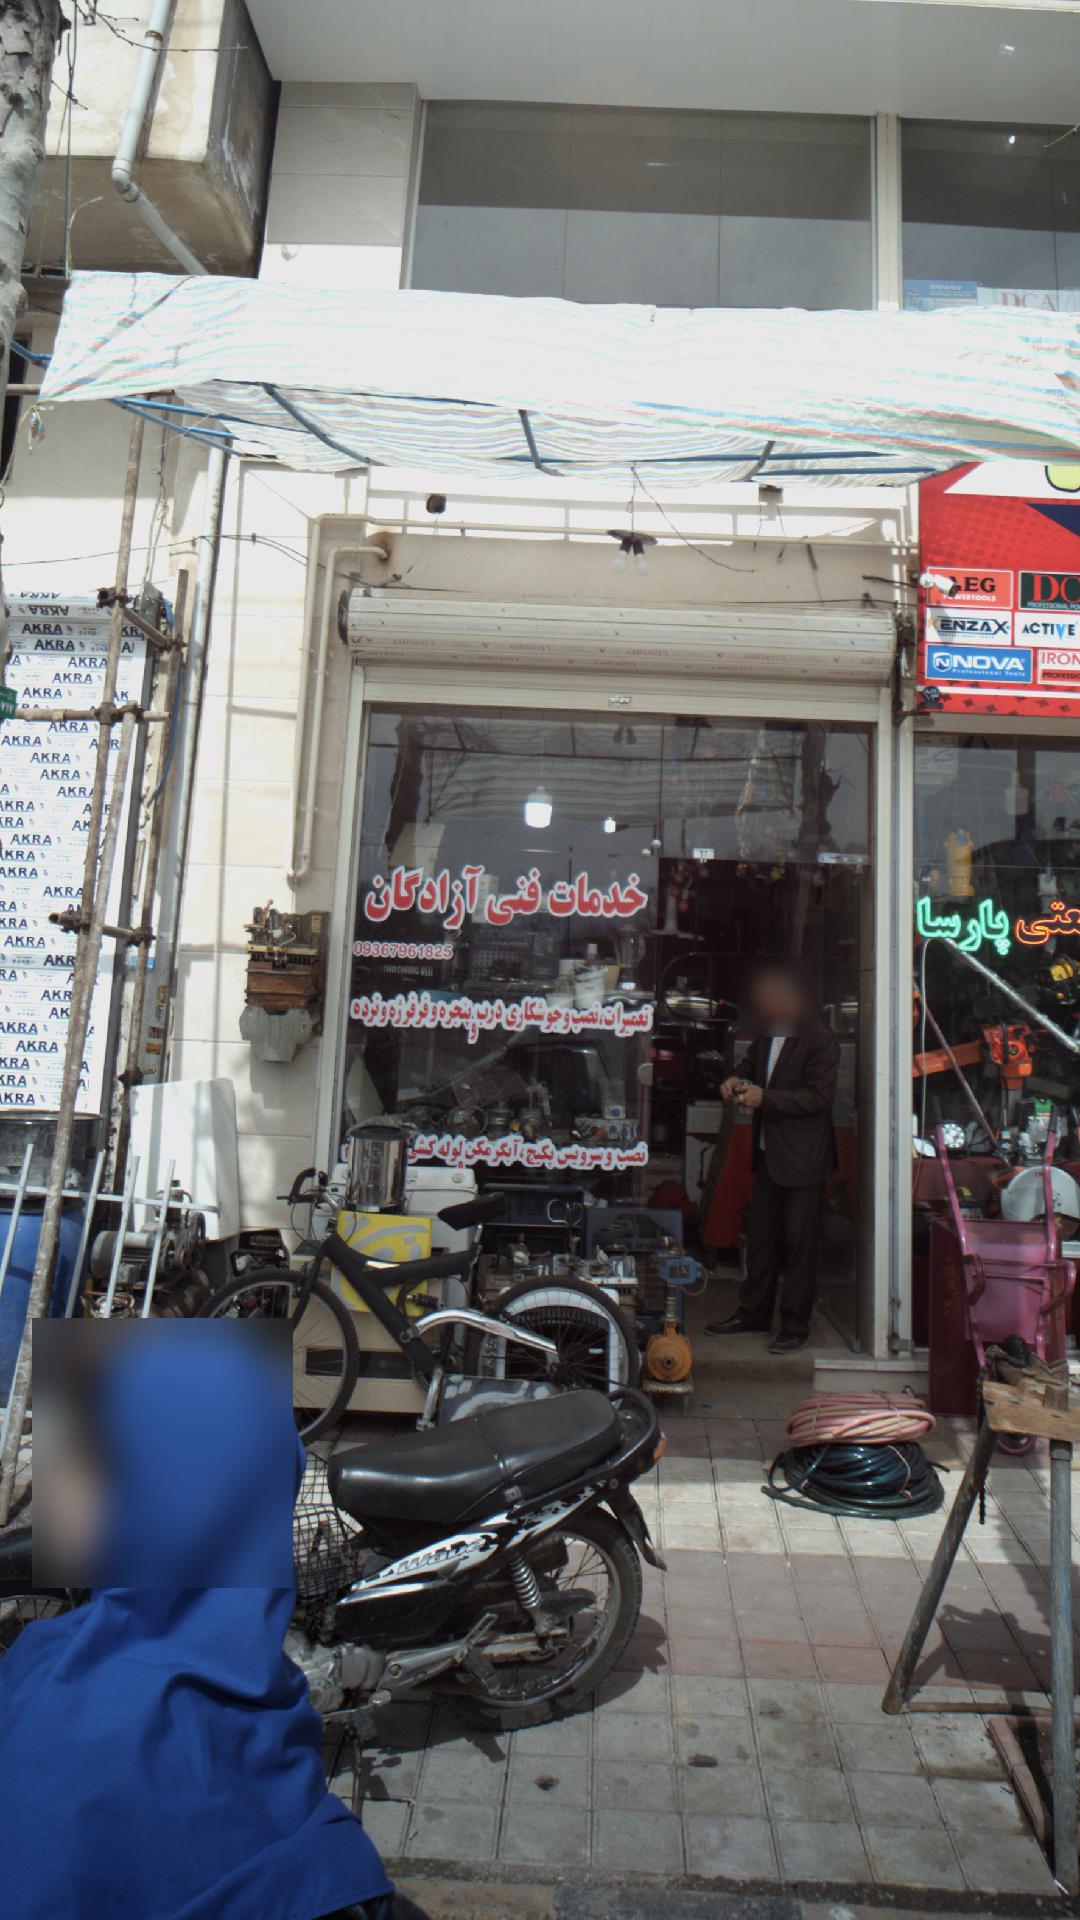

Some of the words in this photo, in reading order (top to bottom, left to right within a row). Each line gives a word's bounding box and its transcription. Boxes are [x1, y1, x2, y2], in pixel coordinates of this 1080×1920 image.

[28, 605, 69, 616] AKRA
[22, 623, 63, 635] AKRA
[1022, 622, 1076, 640] ACTIVE
[34, 639, 75, 652] AKRA
[67, 656, 107, 669] AKRA
[952, 655, 1025, 671] NOVA
[52, 672, 93, 684] AKRA
[22, 686, 62, 698] AKRA
[48, 720, 89, 733] AKRA
[1, 735, 41, 747] AKRA
[30, 752, 71, 764] AKRA
[40, 769, 81, 780] AKRA
[0, 817, 24, 828] RA
[10, 833, 52, 846] AKRA
[0, 849, 35, 861] KRA
[364, 864, 485, 928] آزادگان
[486, 867, 543, 926] فنی
[548, 872, 648, 917] خدمات
[916, 896, 1011, 955] پارسا
[4, 935, 45, 948] AKRA
[353, 941, 454, 960] 09367961825
[439, 997, 473, 1029] پنجره
[478, 999, 504, 1029] درب
[504, 996, 562, 1032] جوشکاری
[571, 1002, 599, 1033] نصب
[16, 1039, 58, 1052] AKRA
[0, 1091, 35, 1104] KRA
[438, 1134, 465, 1165] لوله
[616, 1141, 648, 1170] نصب
[557, 1144, 602, 1169] سرویس
